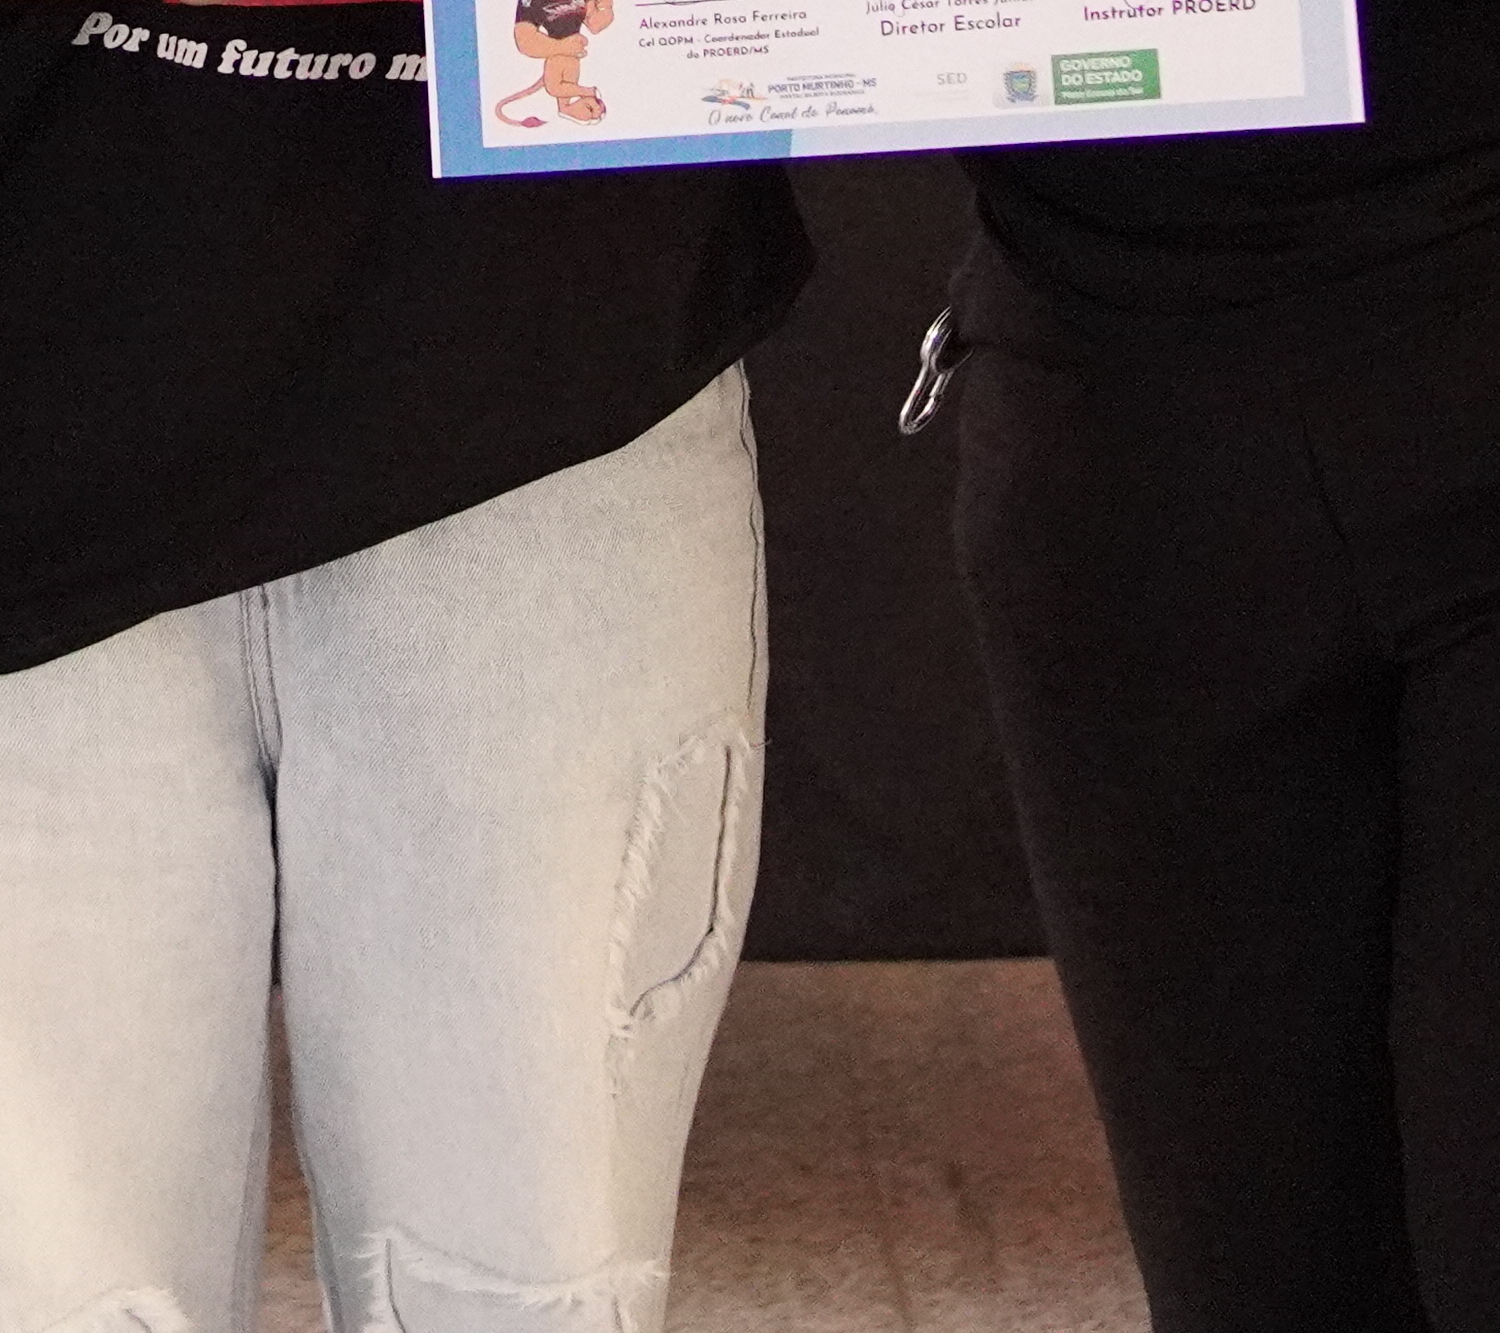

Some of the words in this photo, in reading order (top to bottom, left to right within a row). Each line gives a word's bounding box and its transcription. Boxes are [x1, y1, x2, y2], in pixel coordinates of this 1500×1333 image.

[639, 14, 708, 30] Alexandre
[713, 12, 748, 25] Rosa
[752, 10, 807, 23] Ferreira
[1083, 5, 1165, 22] Instrutor
[880, 19, 946, 37] Diretor
[954, 11, 1022, 32] Escolar
[71, 11, 151, 53] Por
[156, 32, 209, 69] um
[216, 39, 377, 81] futuro
[638, 37, 656, 48] Cel
[1060, 55, 1132, 72] GOVERNO
[936, 71, 968, 86] SED
[1061, 73, 1084, 86] DO
[1084, 69, 1143, 85] ESTADO
[767, 83, 801, 94] PORTO
